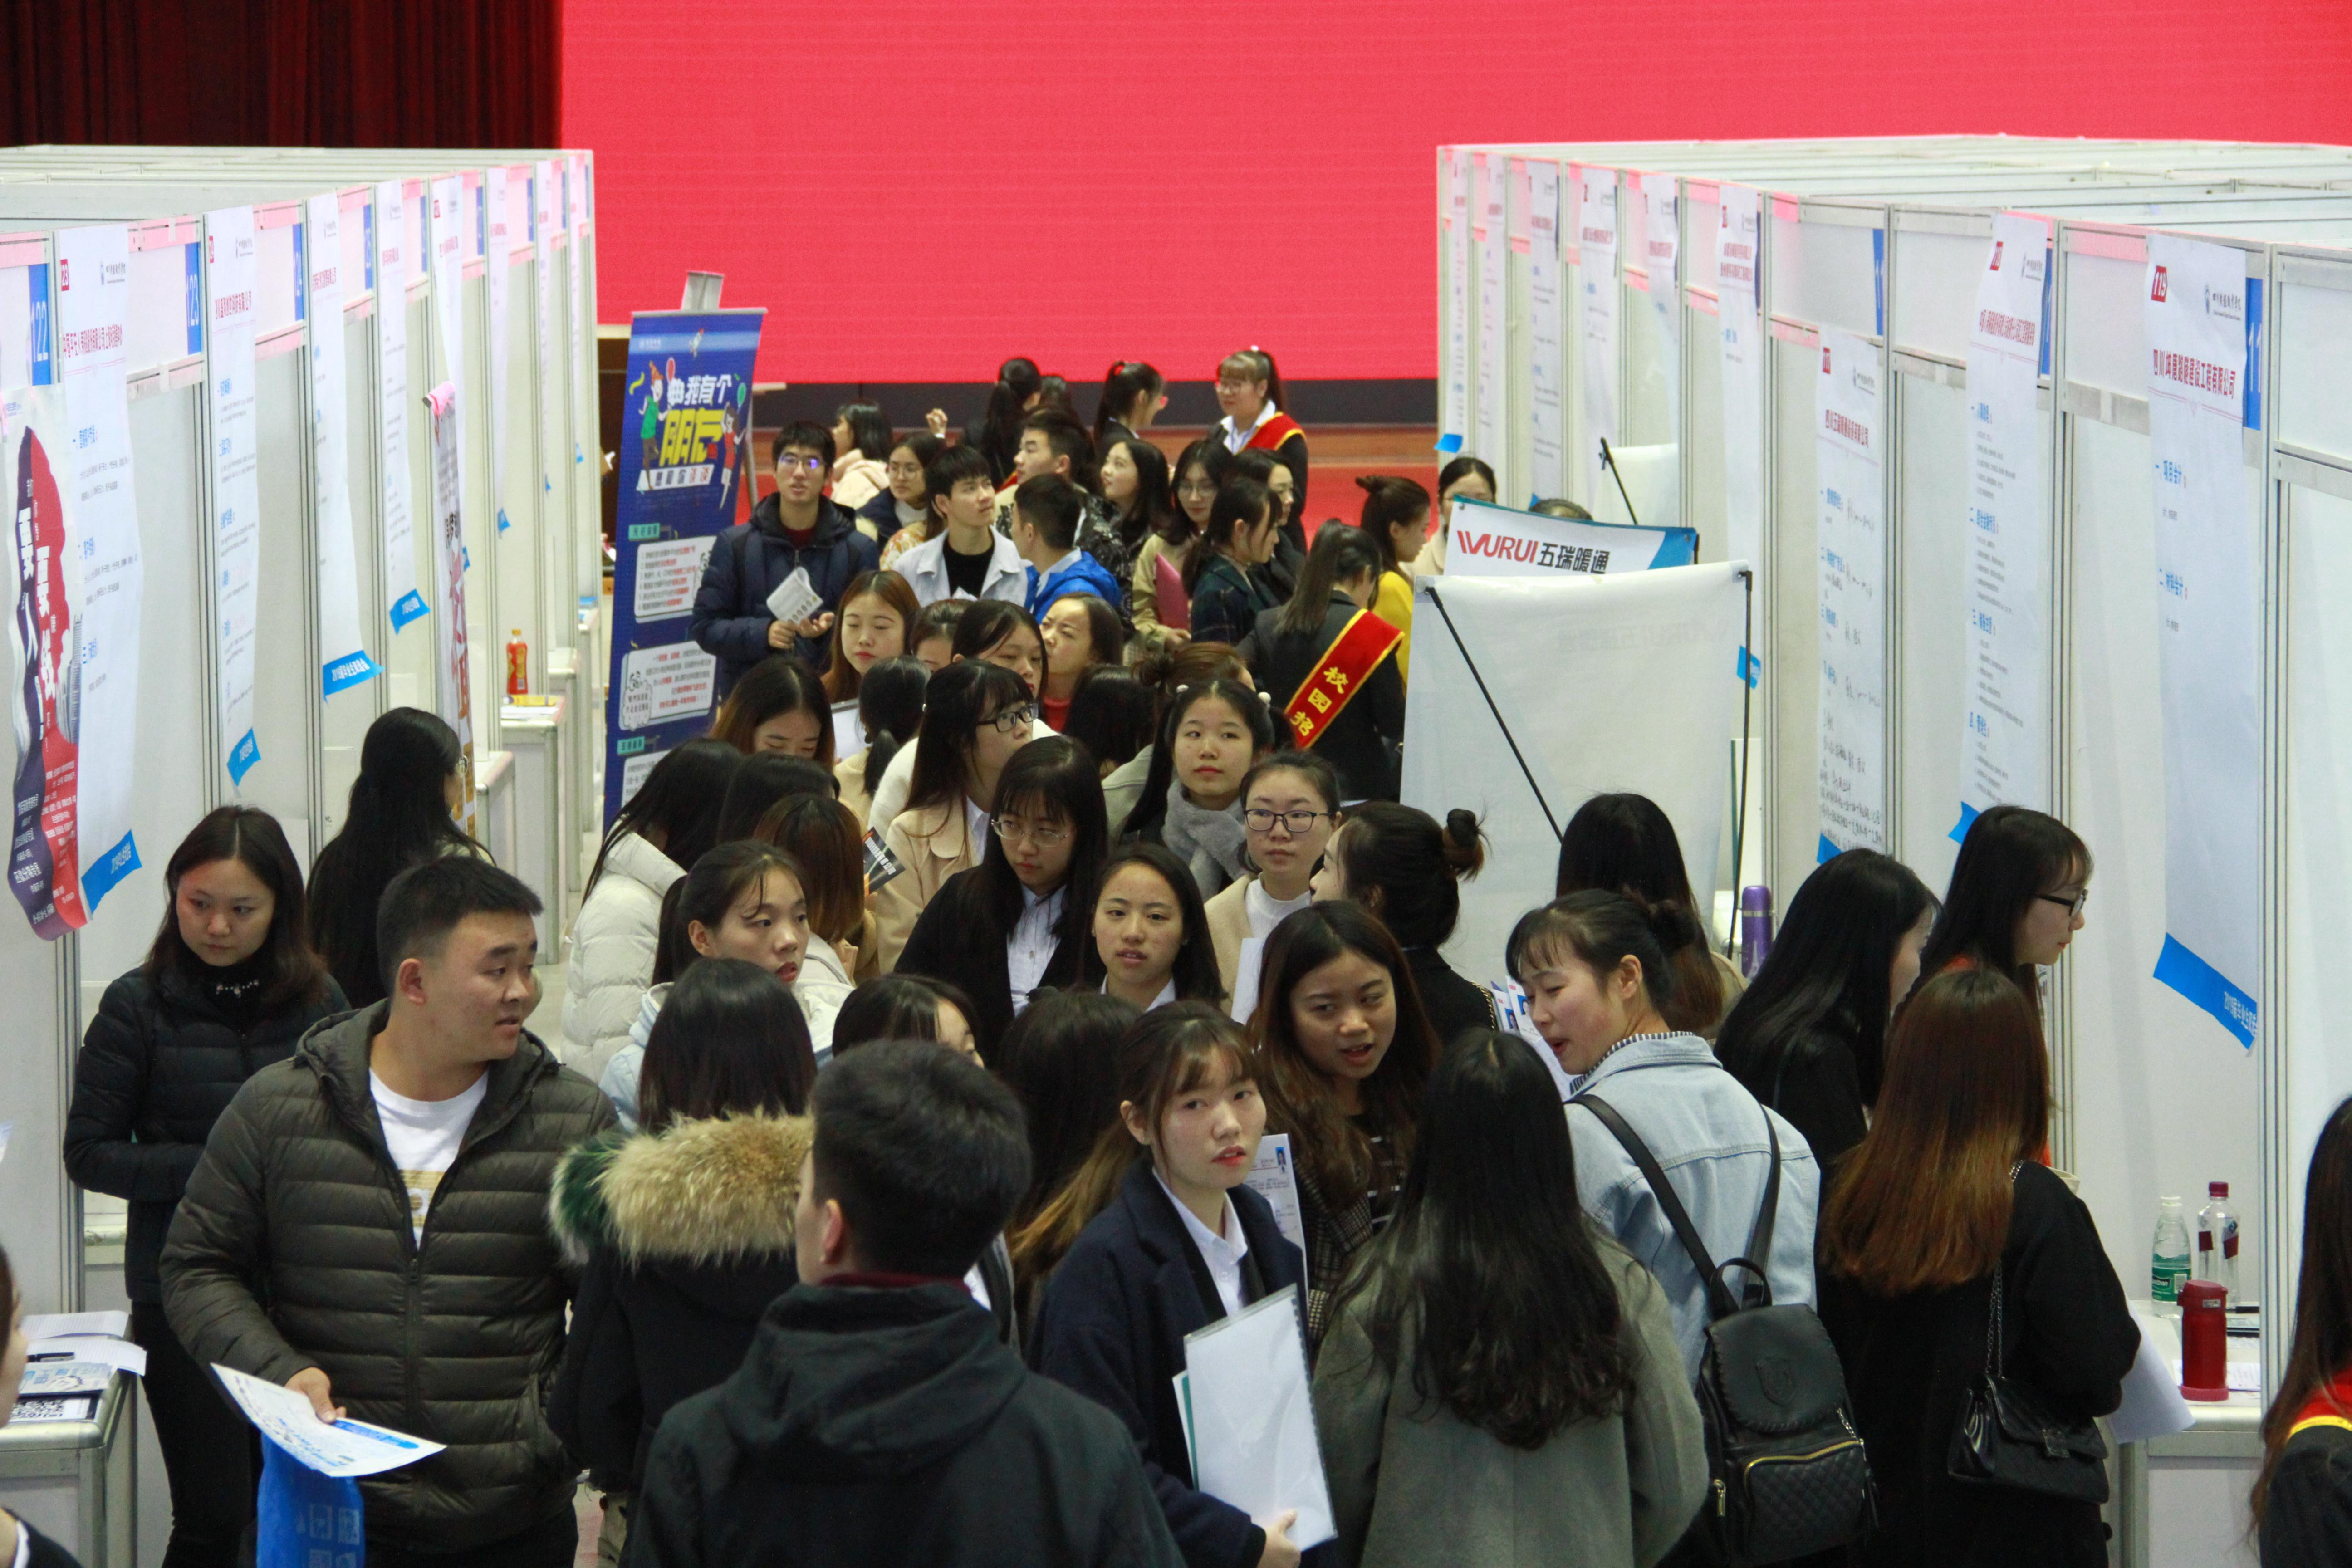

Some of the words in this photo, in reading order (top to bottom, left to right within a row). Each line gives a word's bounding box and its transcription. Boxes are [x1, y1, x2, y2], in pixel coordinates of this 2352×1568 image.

[185, 271, 200, 328] 123
[2152, 270, 2167, 298] 119
[30, 299, 48, 363] 122
[1537, 542, 1610, 574] 五瑞暖通
[1290, 666, 1349, 737] 校园招
